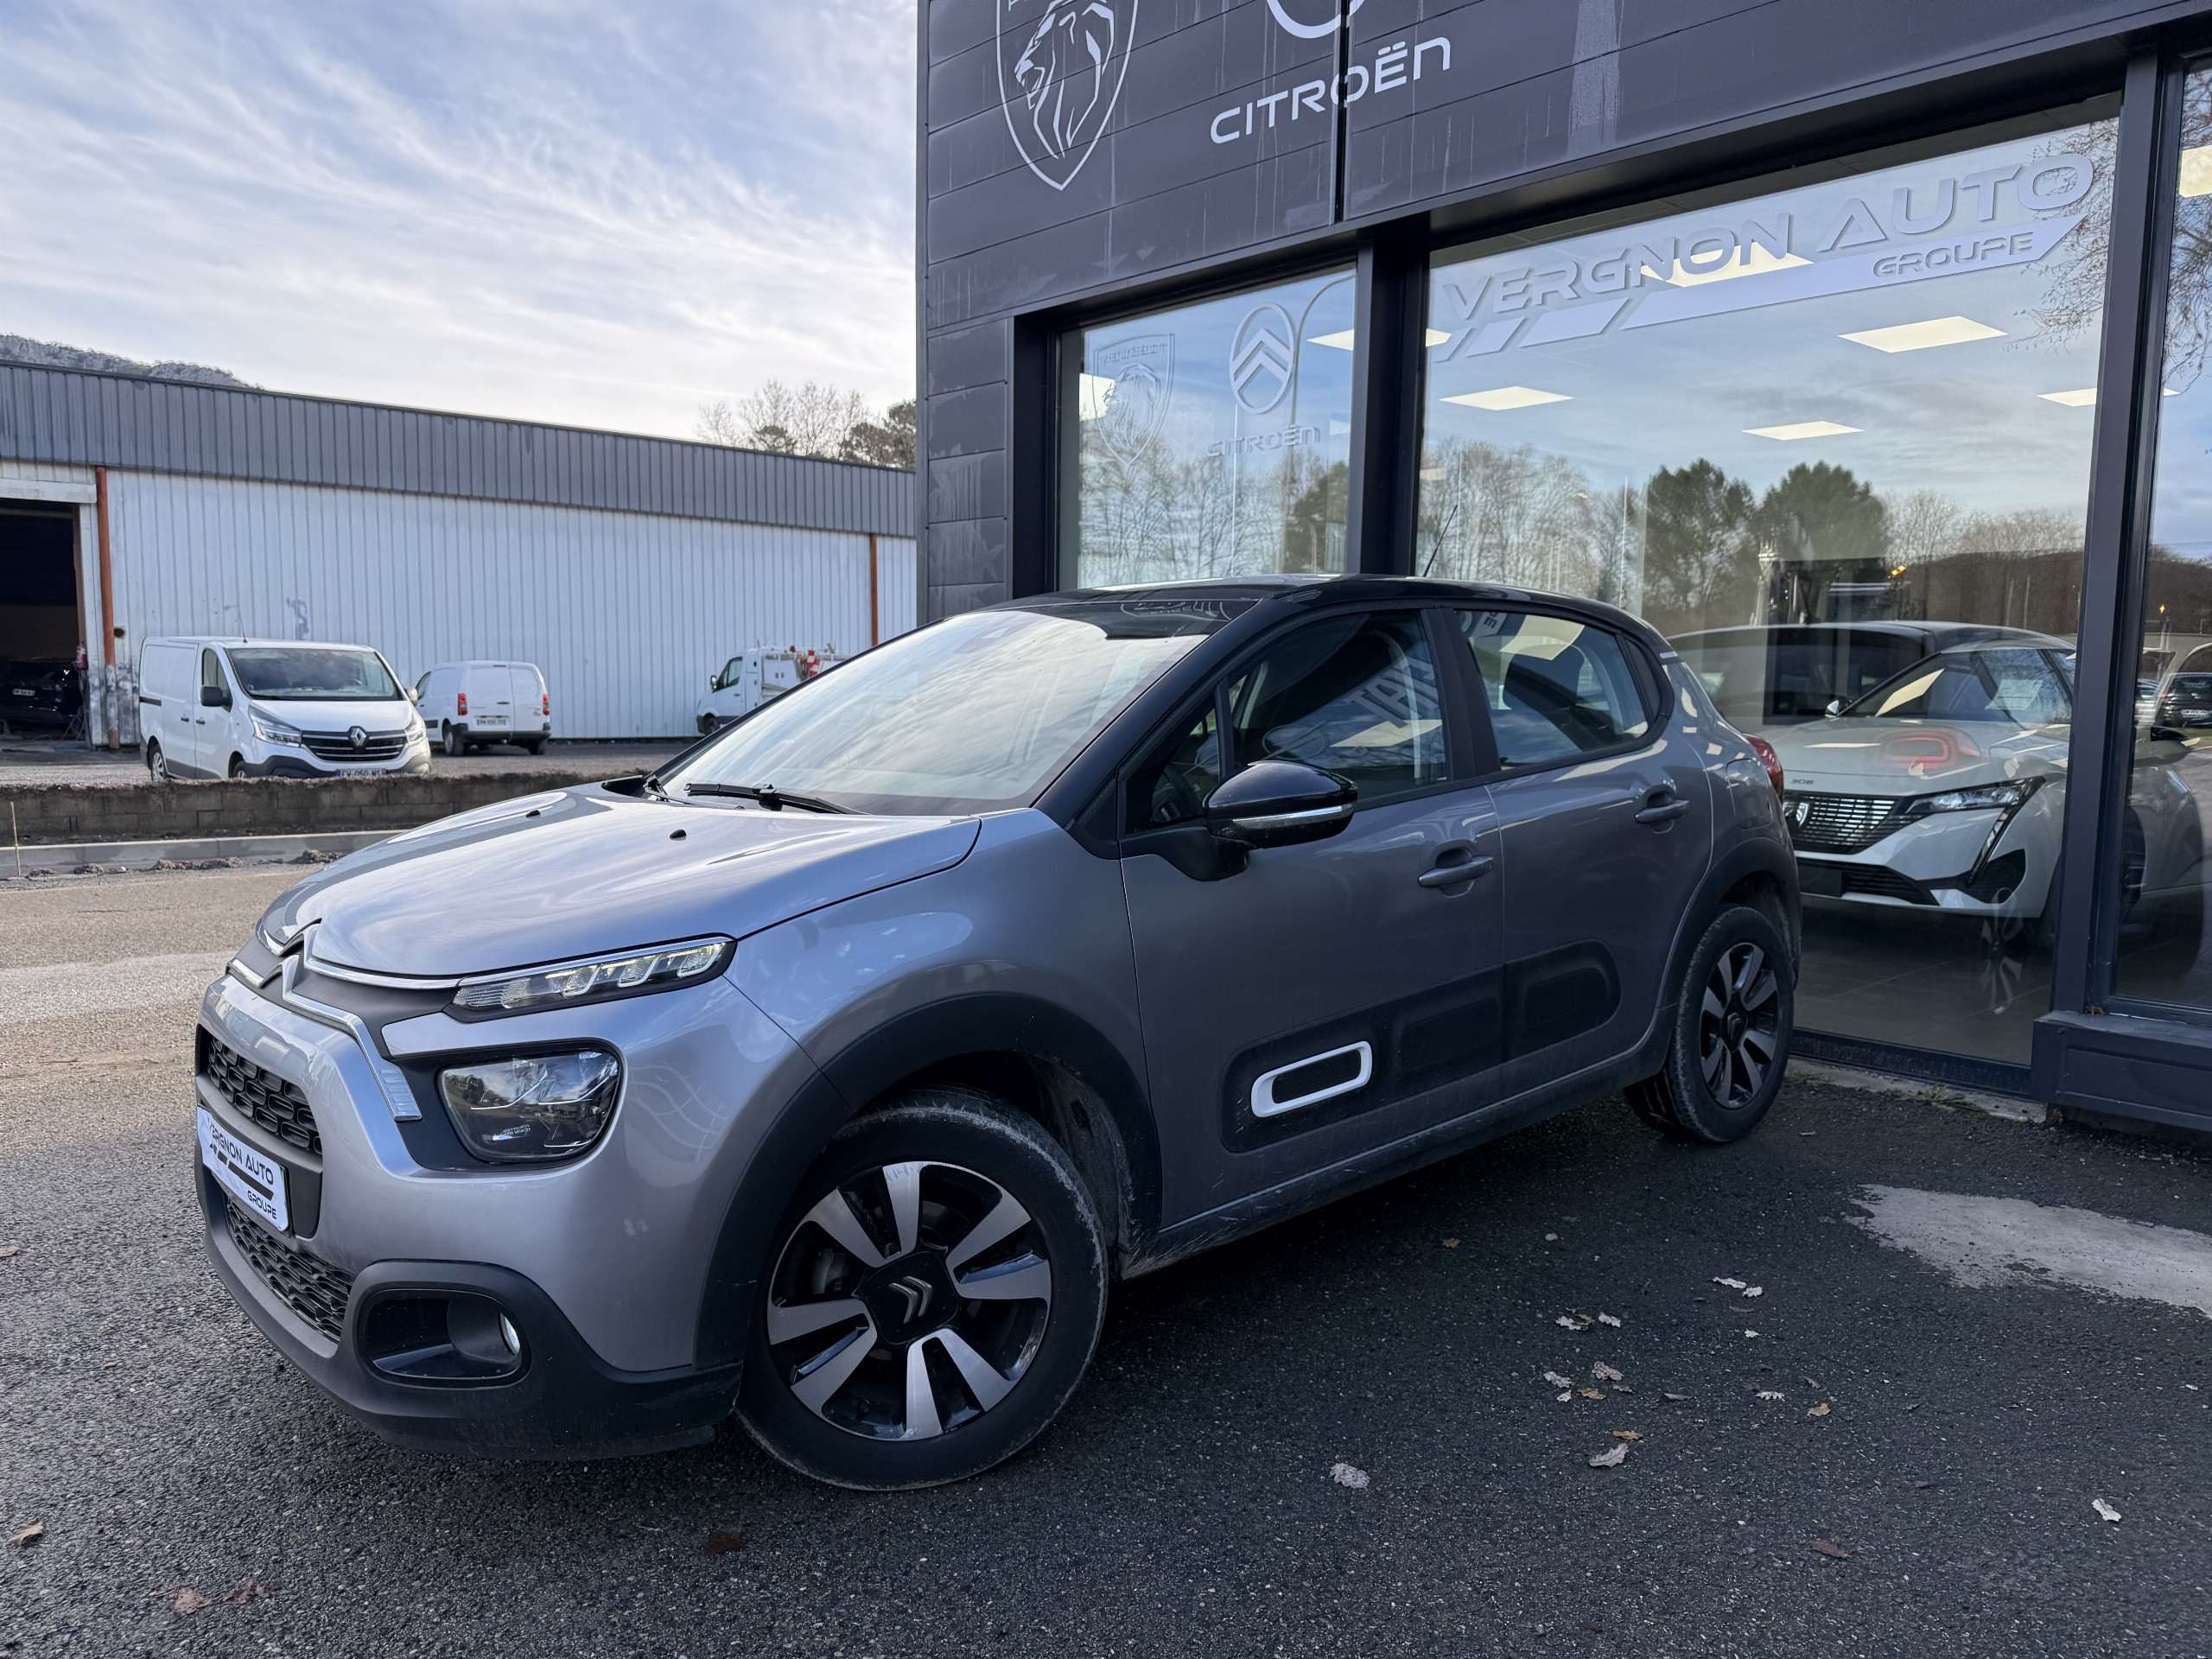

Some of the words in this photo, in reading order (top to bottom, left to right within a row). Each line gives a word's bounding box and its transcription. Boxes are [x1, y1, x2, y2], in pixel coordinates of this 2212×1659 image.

[1211, 37, 1450, 144] CITROËN
[1443, 212, 1791, 321] VERGNON
[1816, 153, 2094, 252] AUTO
[1873, 232, 2034, 277] GROUPE
[245, 1154, 274, 1185] AUTO
[247, 1190, 277, 1220] GROUPE
